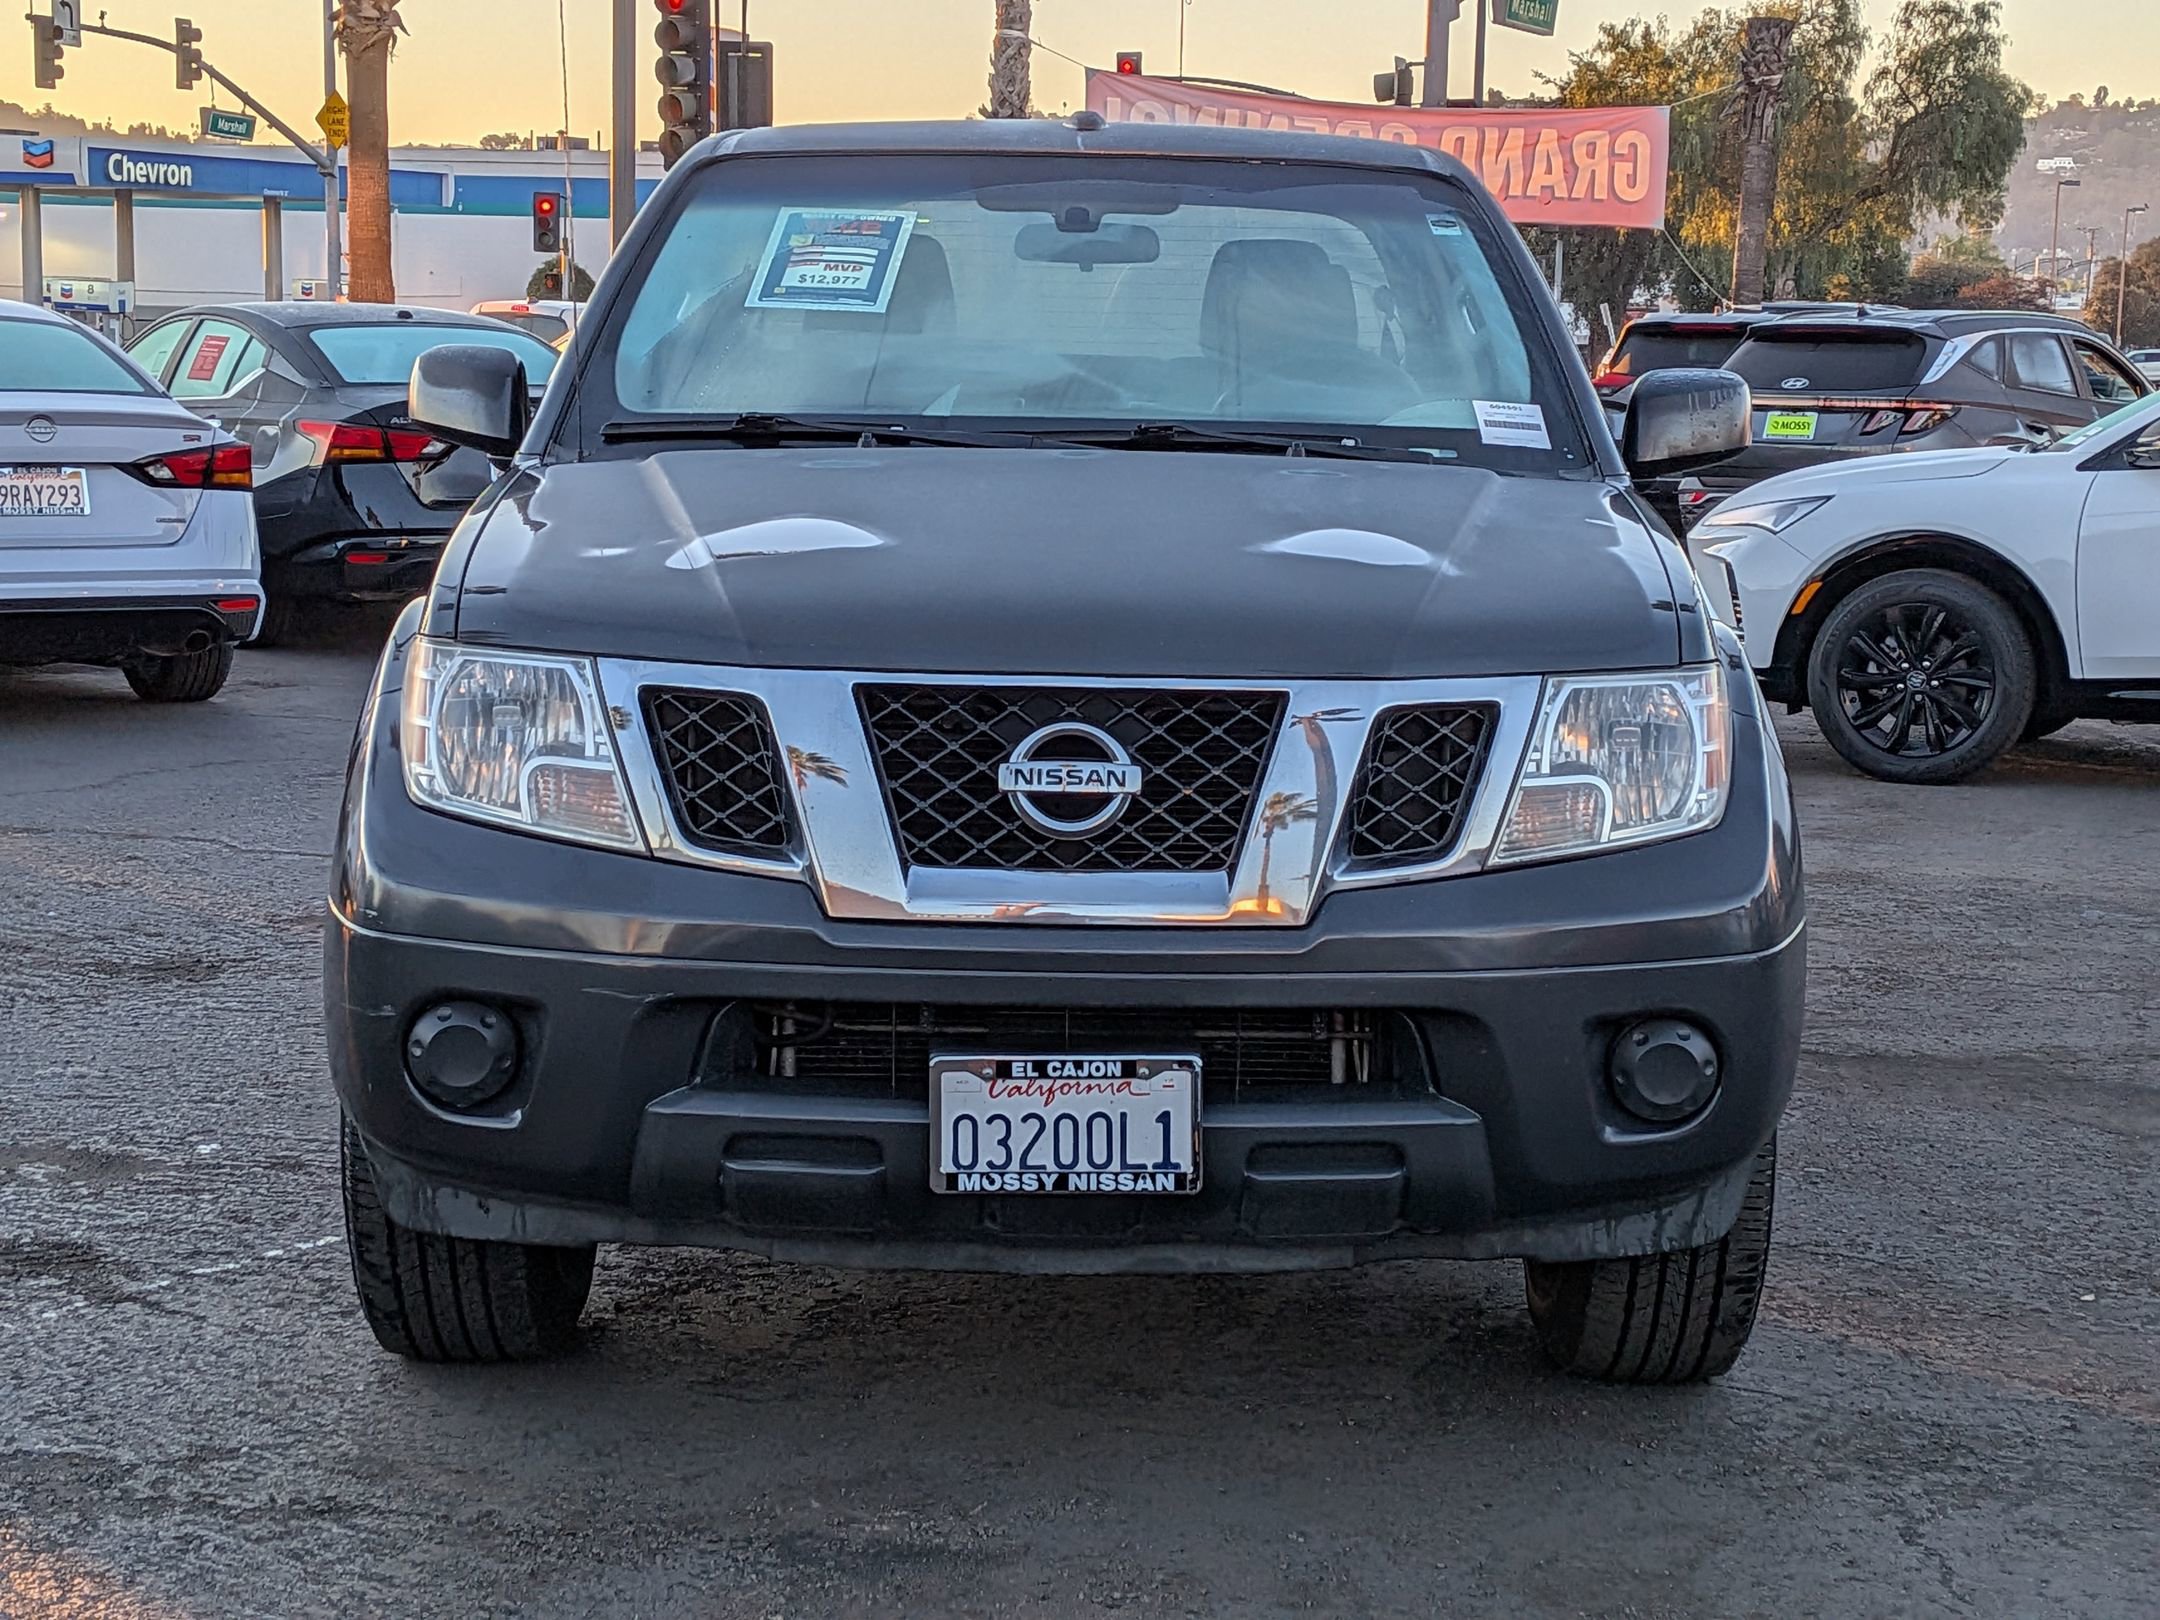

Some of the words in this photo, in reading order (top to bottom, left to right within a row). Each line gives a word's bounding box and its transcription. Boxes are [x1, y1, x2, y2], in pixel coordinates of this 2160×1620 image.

[1510, 0, 1553, 22] Marshall
[217, 117, 247, 134] Marshall
[107, 153, 193, 187] Chevron
[823, 263, 864, 273] MVP
[797, 273, 861, 286] $12,977
[87, 284, 95, 295] 8
[1780, 420, 1811, 430] MOSSY
[183, 434, 202, 442] SR
[0, 485, 81, 507] 9RAY293
[1014, 768, 1127, 787] NISSAN
[1011, 1061, 1039, 1077] EL
[1047, 1061, 1122, 1077] CAJON
[988, 1079, 1150, 1107] California
[952, 1110, 1182, 1170] 03200L1
[957, 1173, 1060, 1191] MOSSY
[1068, 1173, 1175, 1191] NISSAN
